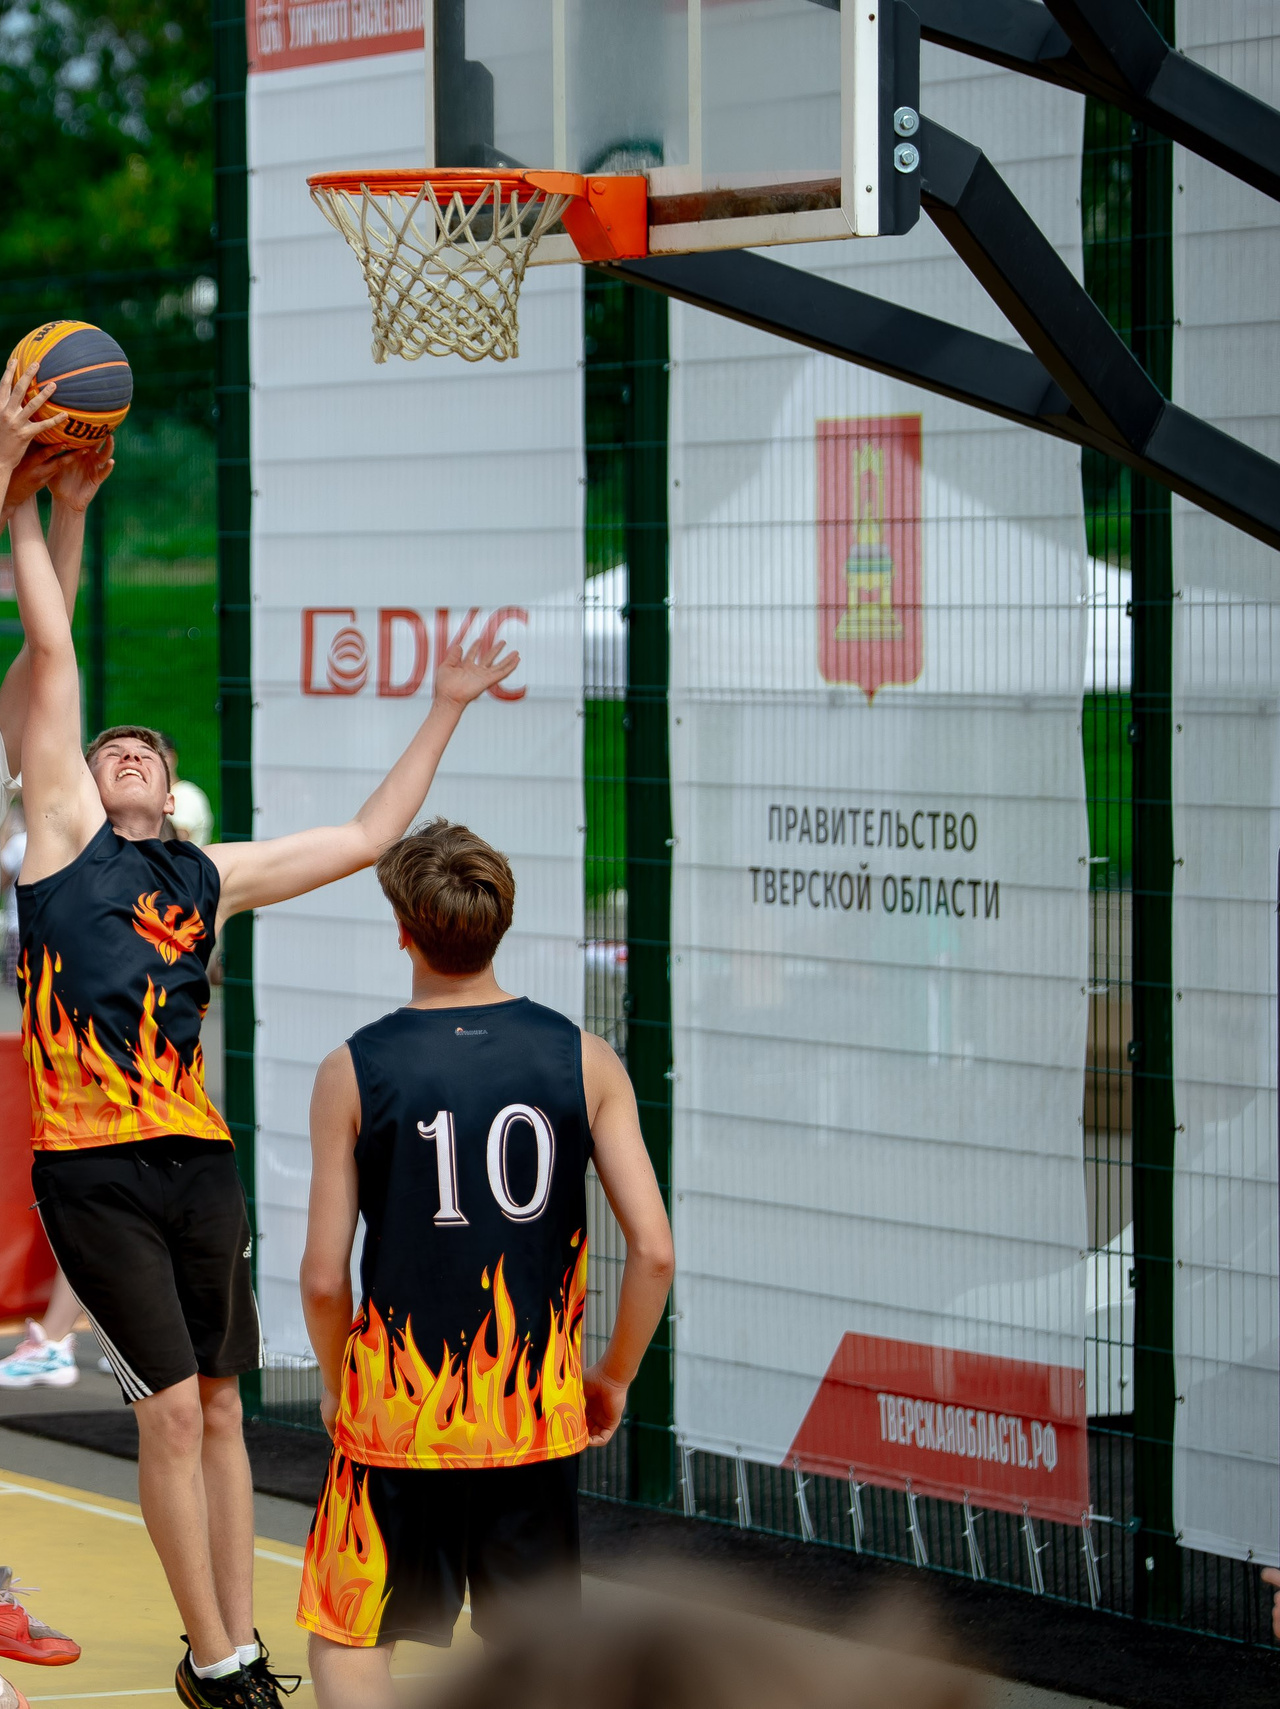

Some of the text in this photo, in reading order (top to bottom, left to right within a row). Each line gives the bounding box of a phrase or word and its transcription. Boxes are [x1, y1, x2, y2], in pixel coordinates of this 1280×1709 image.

[769, 804, 978, 852] ПРАВИТЕЛЬСТВО
[749, 862, 1001, 920] ТВЕРСКОЙ ОБЛАСТИ
[417, 1103, 556, 1227] 10
[877, 1392, 1059, 1473] ТВЕРСКАЯОБЛАСТЬ.РФ
